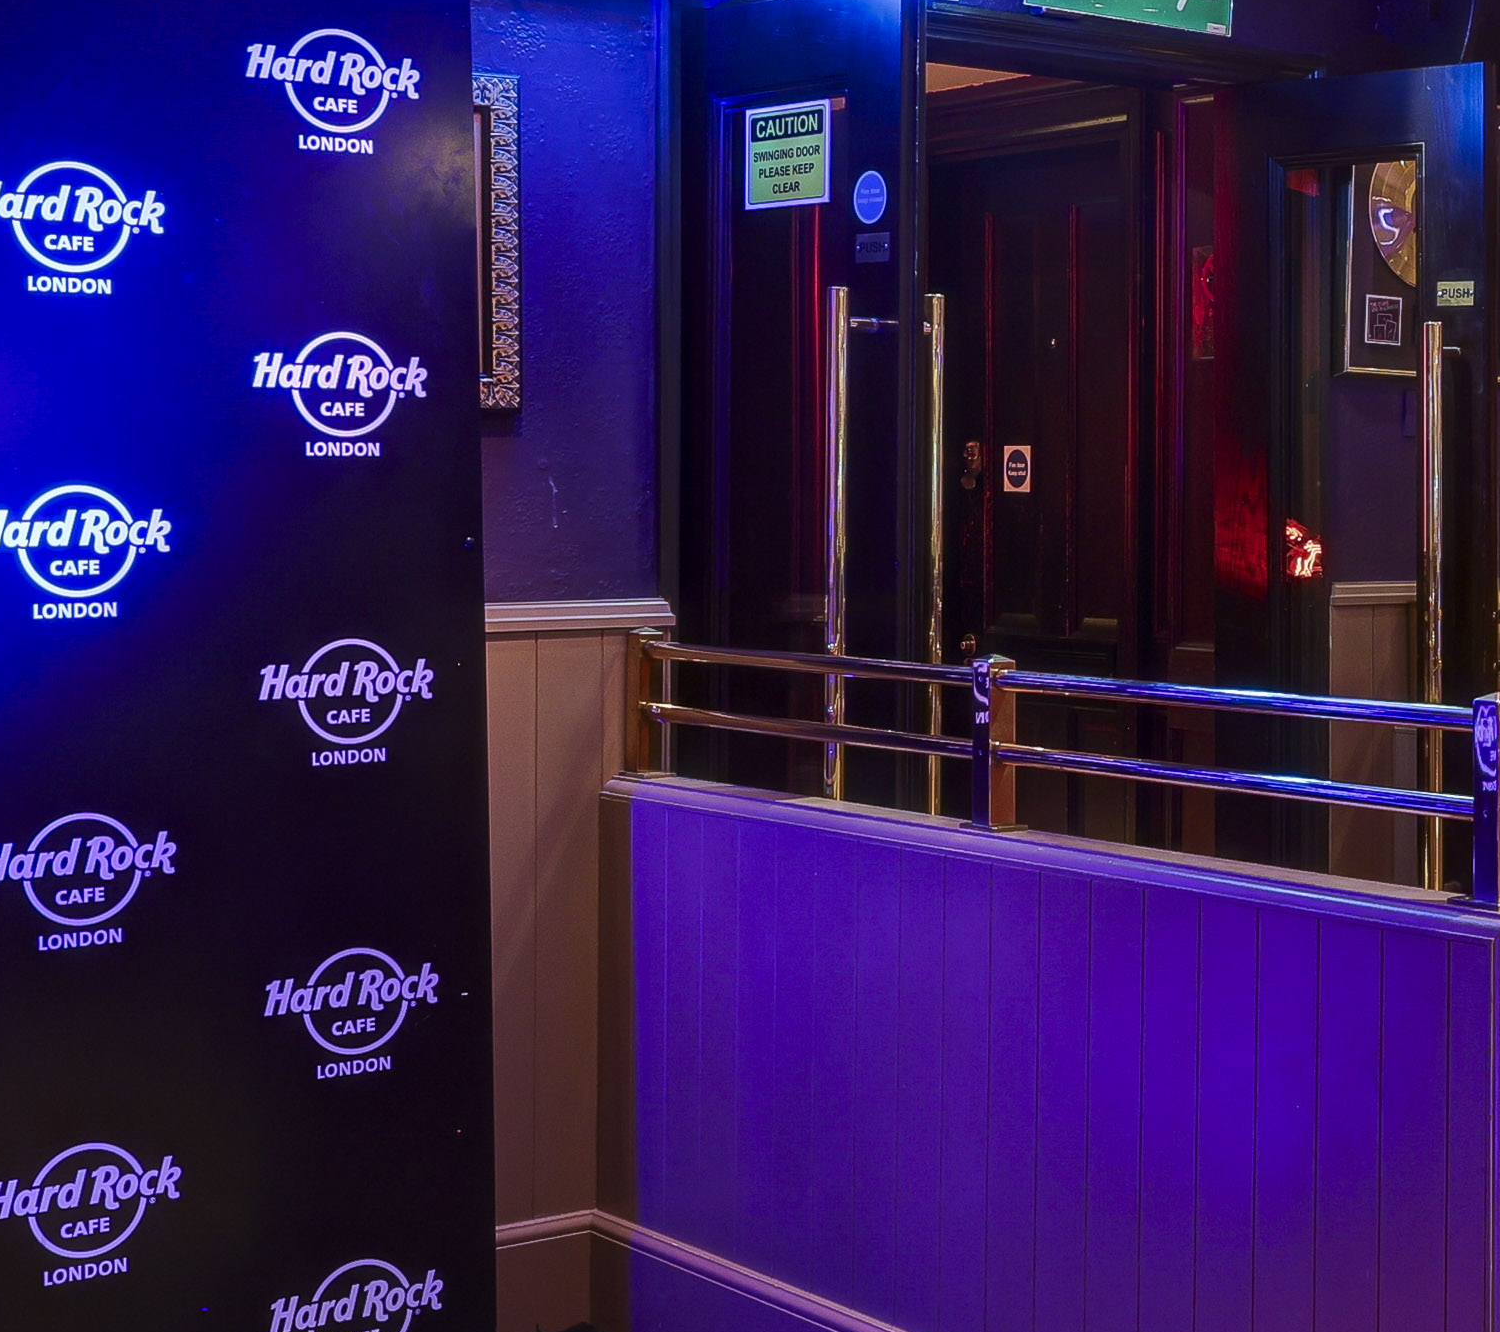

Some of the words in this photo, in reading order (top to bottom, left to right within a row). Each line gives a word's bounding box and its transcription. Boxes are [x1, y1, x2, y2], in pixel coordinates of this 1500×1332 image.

[244, 43, 337, 84] Hard
[338, 51, 420, 100] Rock
[312, 95, 358, 114] CAFE
[756, 113, 819, 139] CAUTION
[298, 134, 374, 155] LONDON
[753, 147, 794, 163] SWINGING
[796, 144, 820, 158] DOOR
[758, 165, 791, 179] PLEASE
[792, 162, 815, 175] KEEP
[772, 181, 800, 194] CLEAR
[72, 185, 165, 234] Rock
[44, 233, 94, 252] CAFE
[859, 241, 886, 253] PUSH
[26, 275, 112, 295] LONDON
[1441, 287, 1470, 299] PUSH
[251, 351, 345, 389] Hard
[345, 354, 428, 398] Rock
[320, 401, 365, 417] CAFE
[305, 441, 380, 457] LONDON
[78, 508, 172, 555] Rock
[49, 559, 100, 576] CAFE
[32, 601, 117, 620] LONDON
[258, 660, 351, 701] Hard
[351, 657, 434, 703] Rock
[326, 707, 371, 725] CAFE
[310, 747, 386, 767] LONDON
[83, 829, 177, 881] Rock
[54, 885, 106, 906] CAFE
[37, 927, 123, 951] LONDON
[263, 970, 356, 1018] Hard
[356, 961, 440, 1012] Rock
[331, 1016, 376, 1037] CAFE
[316, 1055, 392, 1080] LONDON
[88, 1154, 182, 1211] Rock
[60, 1215, 111, 1239] CAFE
[42, 1256, 128, 1287] LONDON
[361, 1267, 444, 1323] Rock
